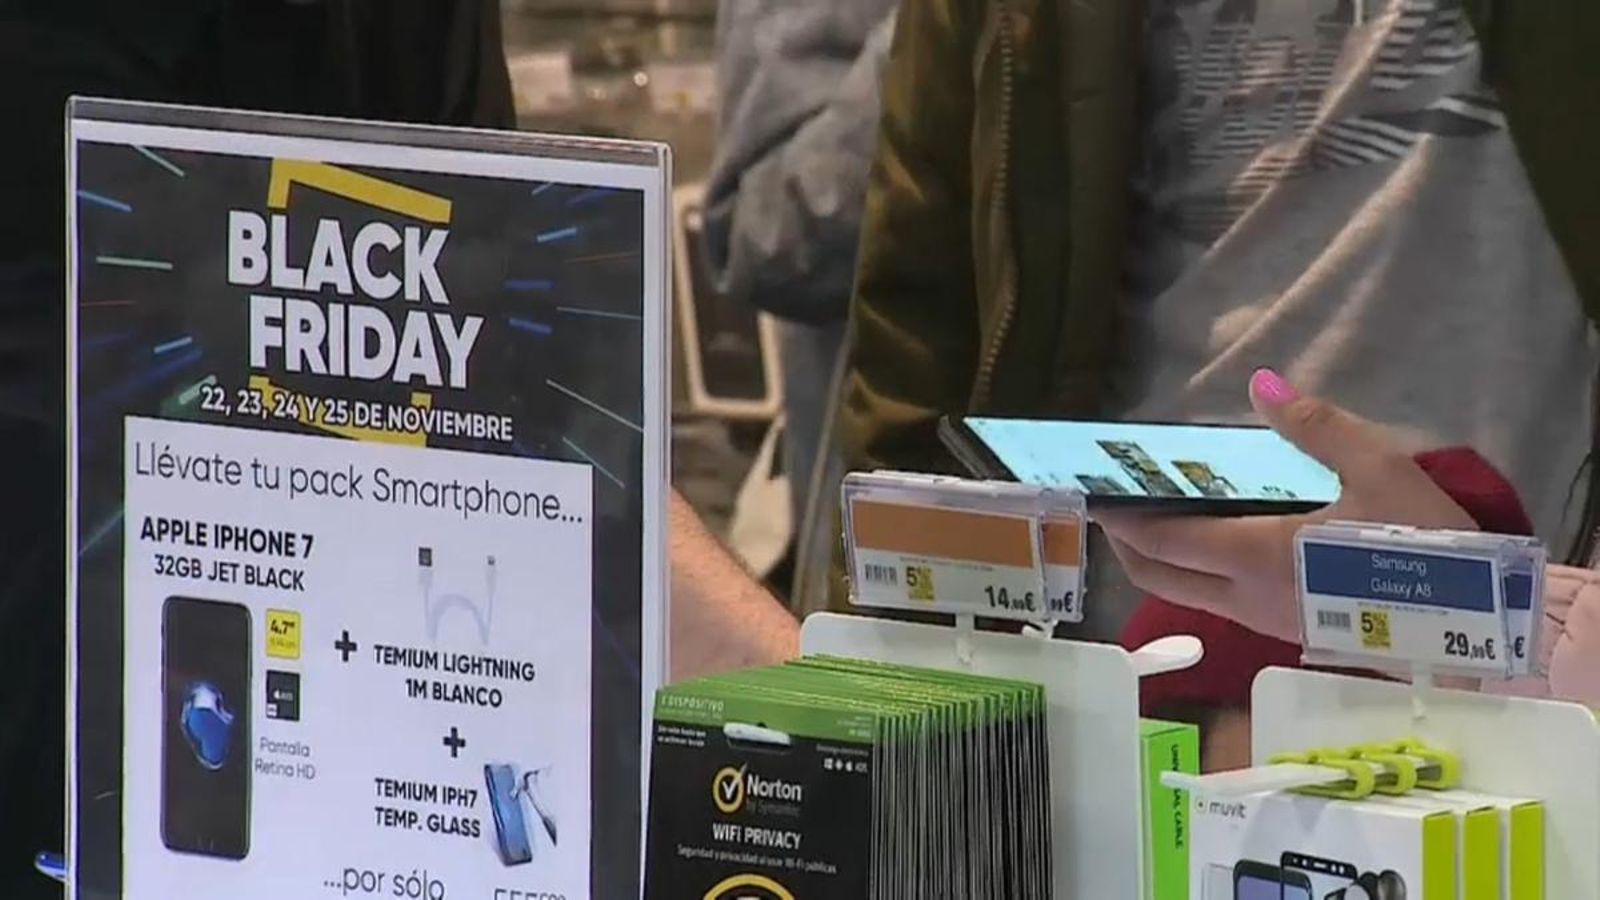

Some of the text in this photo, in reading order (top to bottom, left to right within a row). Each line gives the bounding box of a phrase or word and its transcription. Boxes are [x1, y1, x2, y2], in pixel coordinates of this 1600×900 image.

[226, 208, 450, 304] BLACK
[249, 294, 484, 388] FRIDAY
[201, 386, 513, 441] 22, 23, 24 Y 25 DE NOVIEMBRE
[134, 440, 584, 527] Llévate tu pack Smartphone...
[140, 515, 314, 559] APPLE IPHONE 7
[154, 554, 305, 591] 32GB JET BLACK
[1371, 554, 1427, 576] Samsung
[1370, 578, 1411, 598] Galaxy
[373, 644, 536, 682] TEMIUM LIGHTNING
[406, 678, 502, 708] 1M BLANCO
[260, 736, 310, 758] Pantalla
[255, 758, 316, 780] Retina HD
[1171, 743, 1181, 810] UNIVAL
[374, 778, 478, 809] TEMIUM IPH7
[747, 774, 802, 801] Norton
[374, 806, 481, 838] TEMP. GLASS
[1210, 801, 1246, 819] muvit
[744, 827, 802, 850] PRIVACY
[392, 869, 444, 900] sólo
